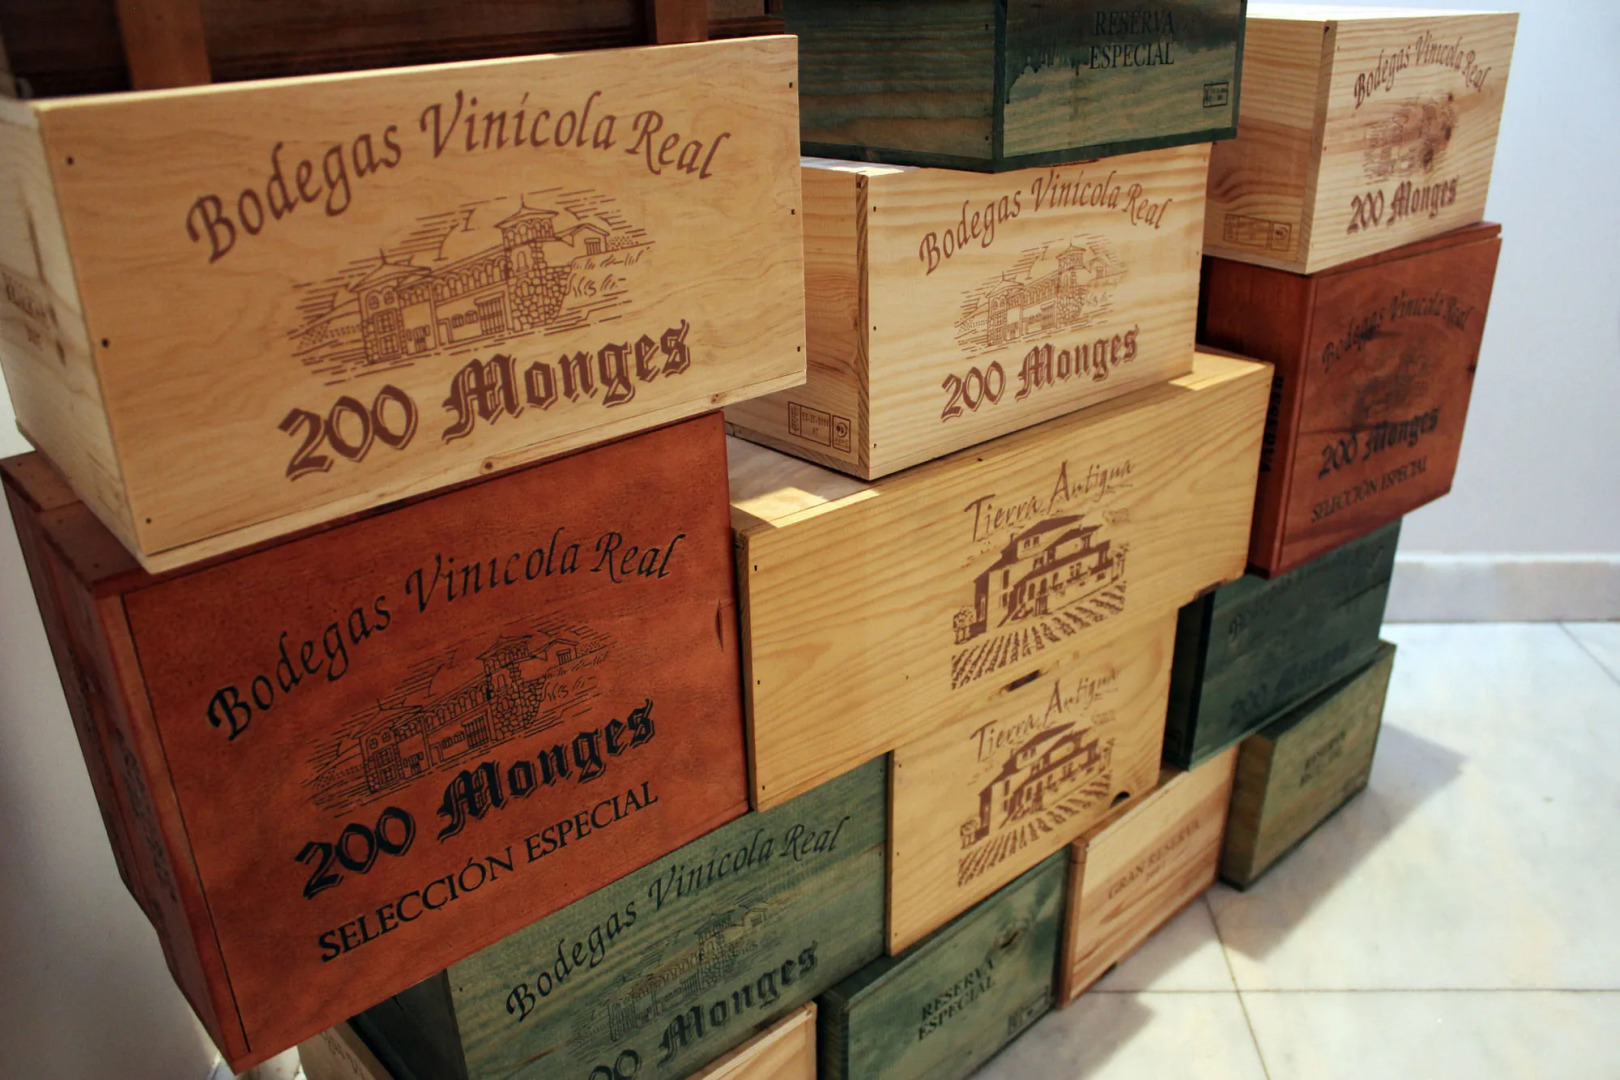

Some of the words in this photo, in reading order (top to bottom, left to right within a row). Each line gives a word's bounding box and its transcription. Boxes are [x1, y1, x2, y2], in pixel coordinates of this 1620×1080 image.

[1089, 41, 1175, 70] ESPECIAL
[1095, 10, 1175, 36] RESERVA
[1354, 46, 1411, 110] Bodegas
[1462, 49, 1493, 93] Real
[185, 124, 402, 265] Bodegas
[419, 88, 619, 159] Vinícola
[625, 109, 732, 179] Real
[918, 189, 1022, 277] Bodegas
[1031, 168, 1122, 213] Vinícola
[1121, 182, 1173, 229] Real
[1346, 188, 1385, 236] 200
[1386, 174, 1460, 226] Monges
[277, 384, 419, 482] 200
[440, 318, 692, 445] Monges
[940, 360, 1007, 423] 200
[1014, 323, 1141, 403] Monges
[1318, 426, 1359, 480] 200
[1361, 404, 1441, 463] Monges
[963, 493, 1043, 543] Tierra
[1046, 459, 1133, 515] Antigua
[205, 592, 392, 742] Bodegas
[589, 530, 687, 584] Real
[969, 719, 1040, 763] Tierra
[1042, 668, 1119, 729] Antigua
[294, 806, 417, 901] 200
[435, 698, 656, 844] Monges
[317, 844, 515, 963] SELECCIÓN
[525, 780, 659, 864] ESPECIAL
[505, 900, 638, 1023] Bodegas
[779, 814, 851, 863] Real
[656, 939, 819, 1070] Monges
[921, 957, 994, 1020] RESERVA
